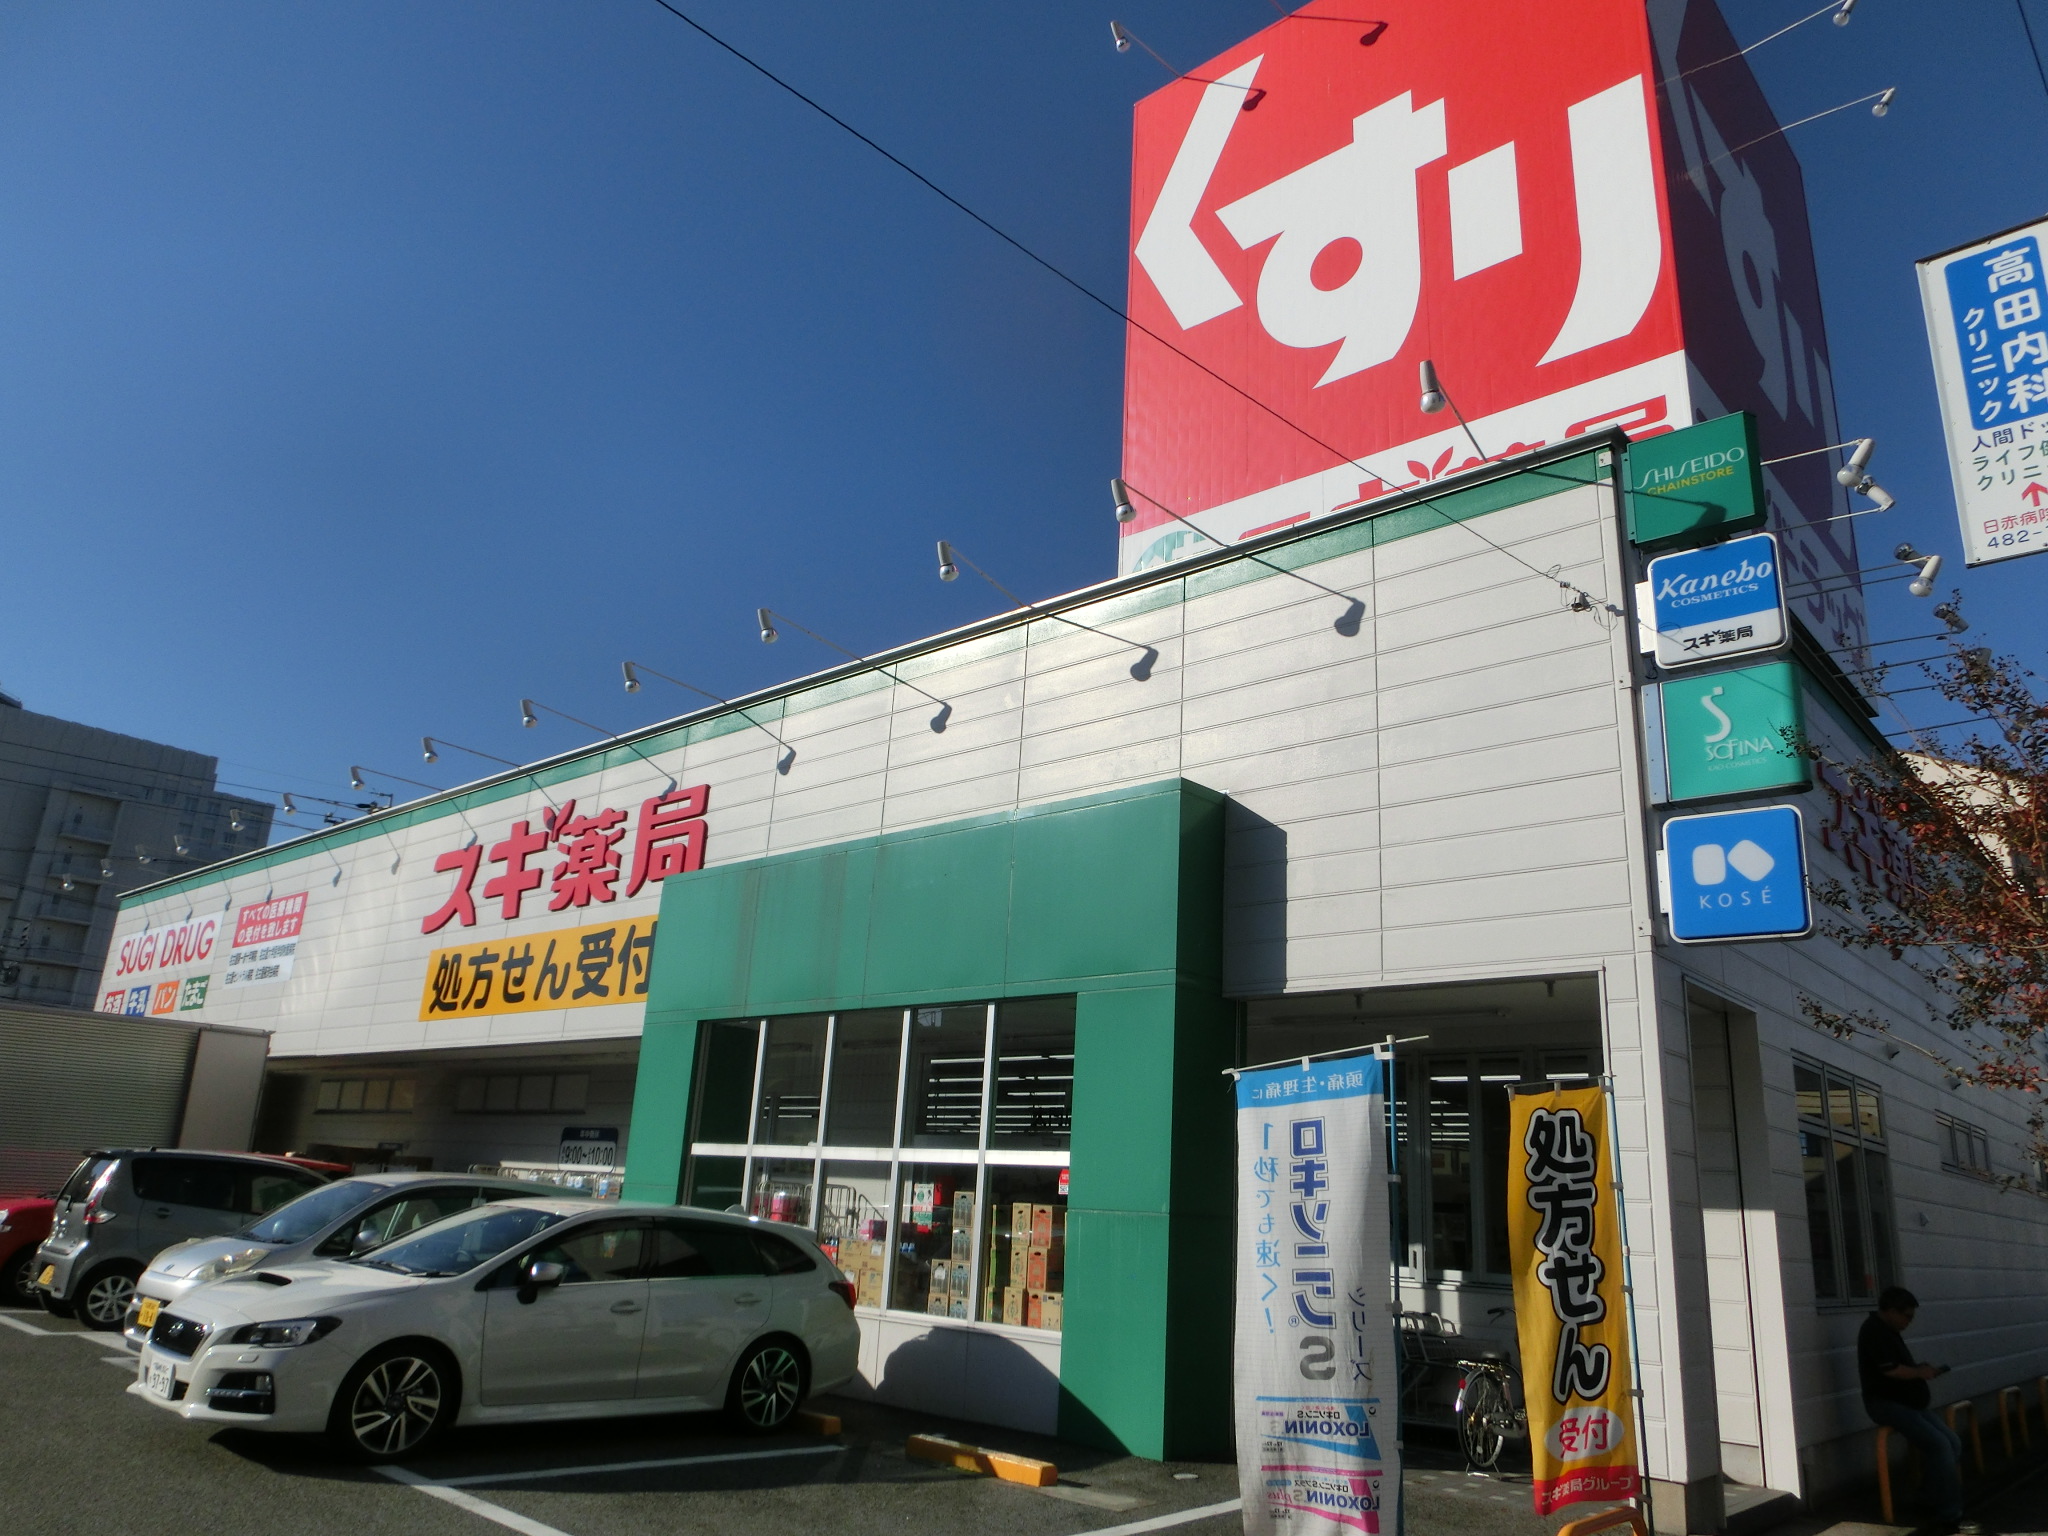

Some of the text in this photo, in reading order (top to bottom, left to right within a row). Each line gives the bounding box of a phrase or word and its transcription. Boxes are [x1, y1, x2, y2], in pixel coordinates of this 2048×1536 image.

[1134, 53, 1661, 389] くすり
[1963, 308, 2002, 423] クリニック
[1637, 447, 1745, 488] SHISEIDO
[1648, 466, 1734, 496] CHAINSTORE
[1977, 465, 2048, 491] クリニ
[1987, 525, 2048, 548] 482-
[1657, 559, 1773, 600] Kanebo
[1671, 582, 1759, 608] COSMETICS
[1683, 624, 1753, 651] スギ薬局
[1706, 737, 1774, 761] SOFINA
[421, 783, 712, 934] スギ薬局
[1700, 887, 1773, 909] KOSÉ
[116, 934, 159, 976] SUGI
[159, 919, 216, 969] DRUG
[429, 920, 658, 1014] 処方せん受付
[128, 989, 145, 1014] 牛乳
[154, 985, 176, 1009] パン
[1525, 1108, 1611, 1404] 処方せん
[1558, 1412, 1610, 1459] 受付
